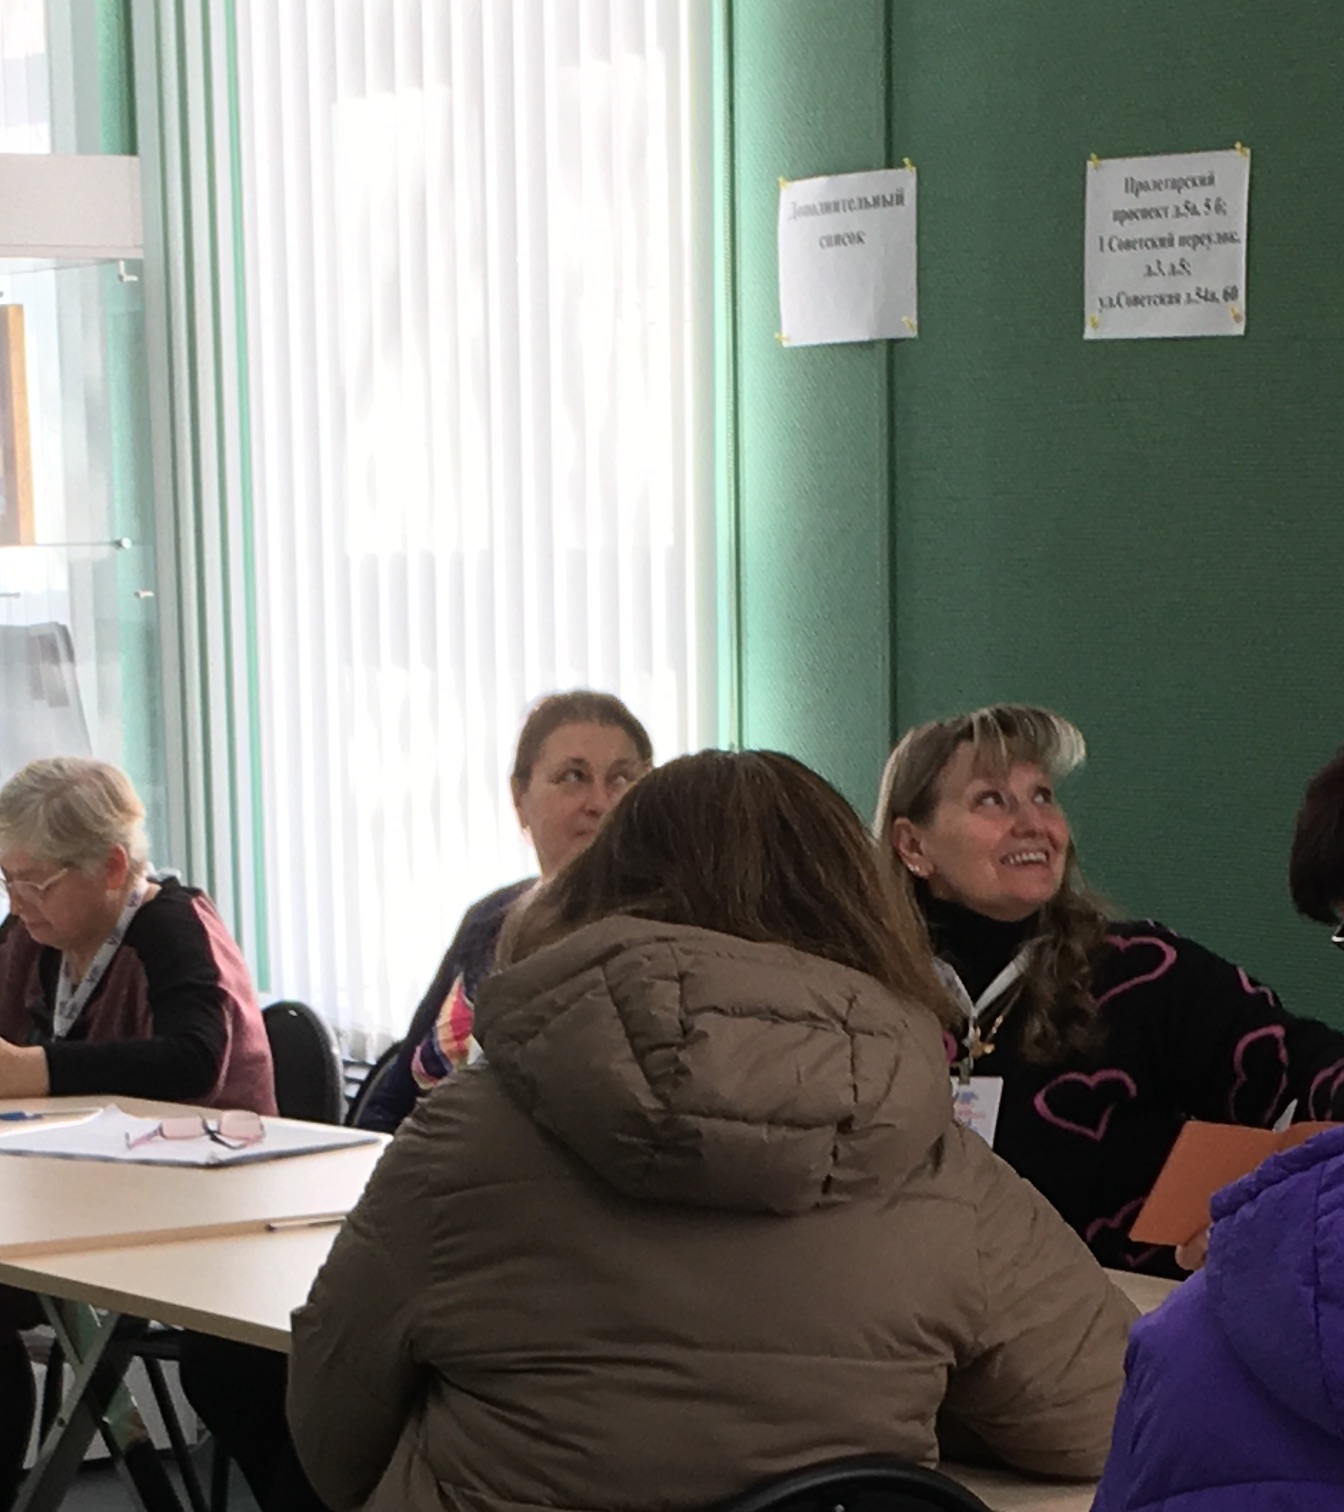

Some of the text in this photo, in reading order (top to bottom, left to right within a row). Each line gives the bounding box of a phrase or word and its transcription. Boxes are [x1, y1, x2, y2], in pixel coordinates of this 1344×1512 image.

[1112, 206, 1169, 226] проспект
[818, 230, 866, 249] список
[1108, 232, 1175, 252] Советский
